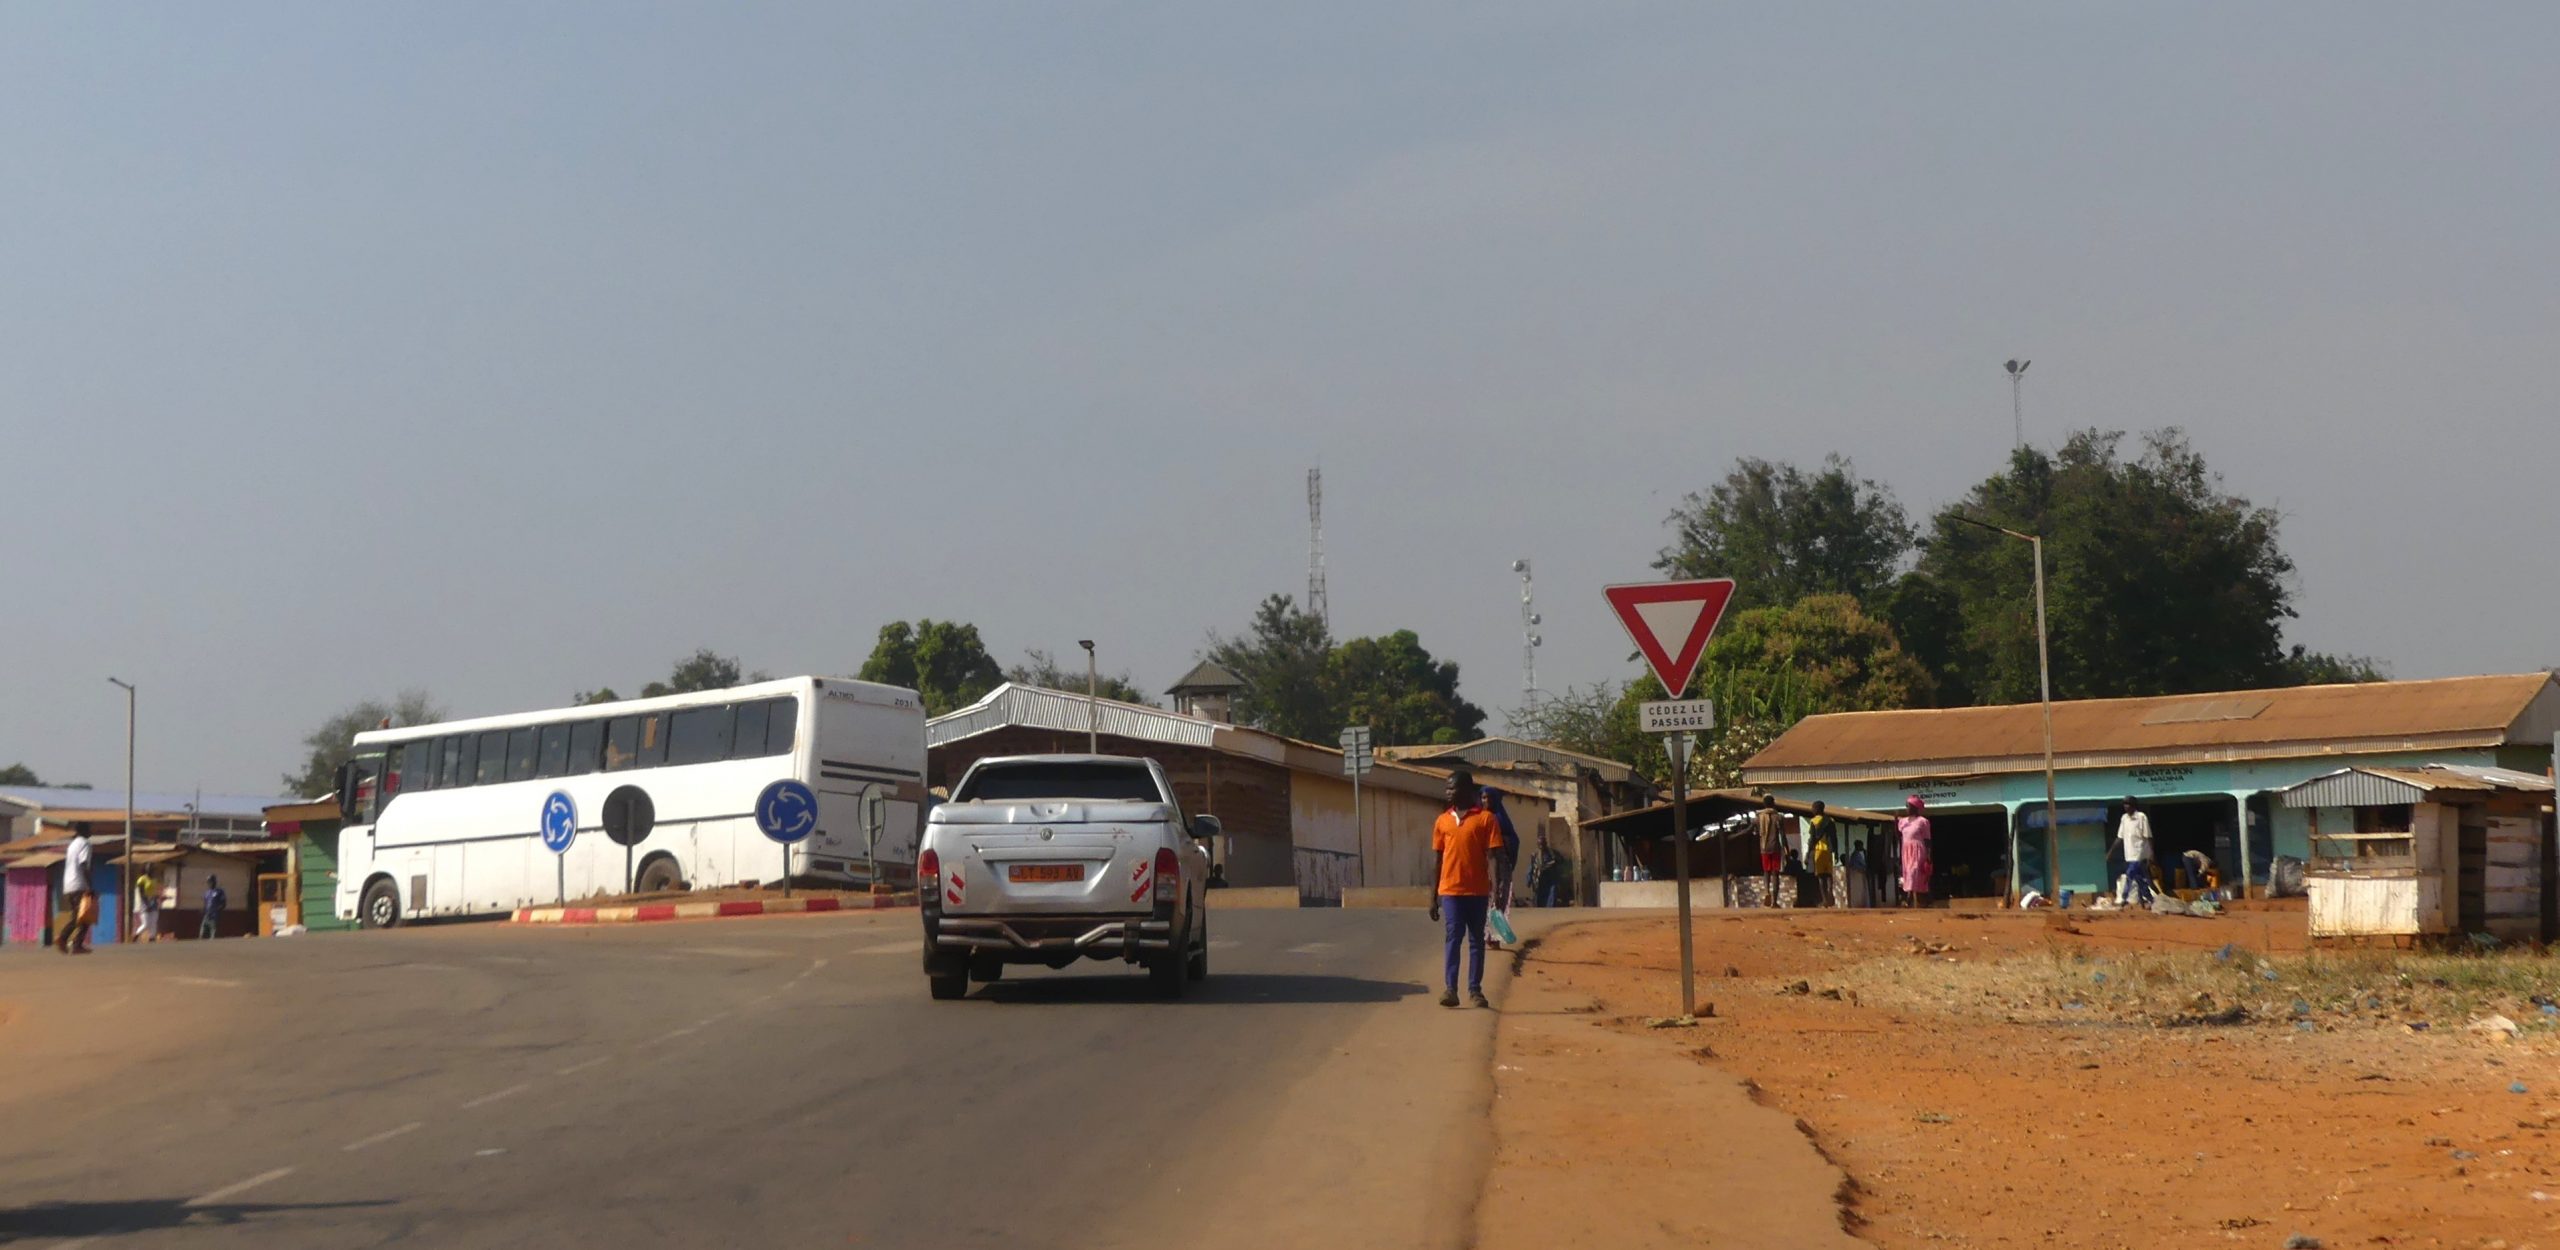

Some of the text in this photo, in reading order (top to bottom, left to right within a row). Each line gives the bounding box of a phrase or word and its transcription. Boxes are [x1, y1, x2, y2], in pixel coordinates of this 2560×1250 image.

[895, 697, 914, 709] 2031
[1648, 703, 1705, 716] CÉDEZ LE
[1651, 716, 1704, 728] PASSAGE
[2128, 767, 2193, 777] ALIMENTATION
